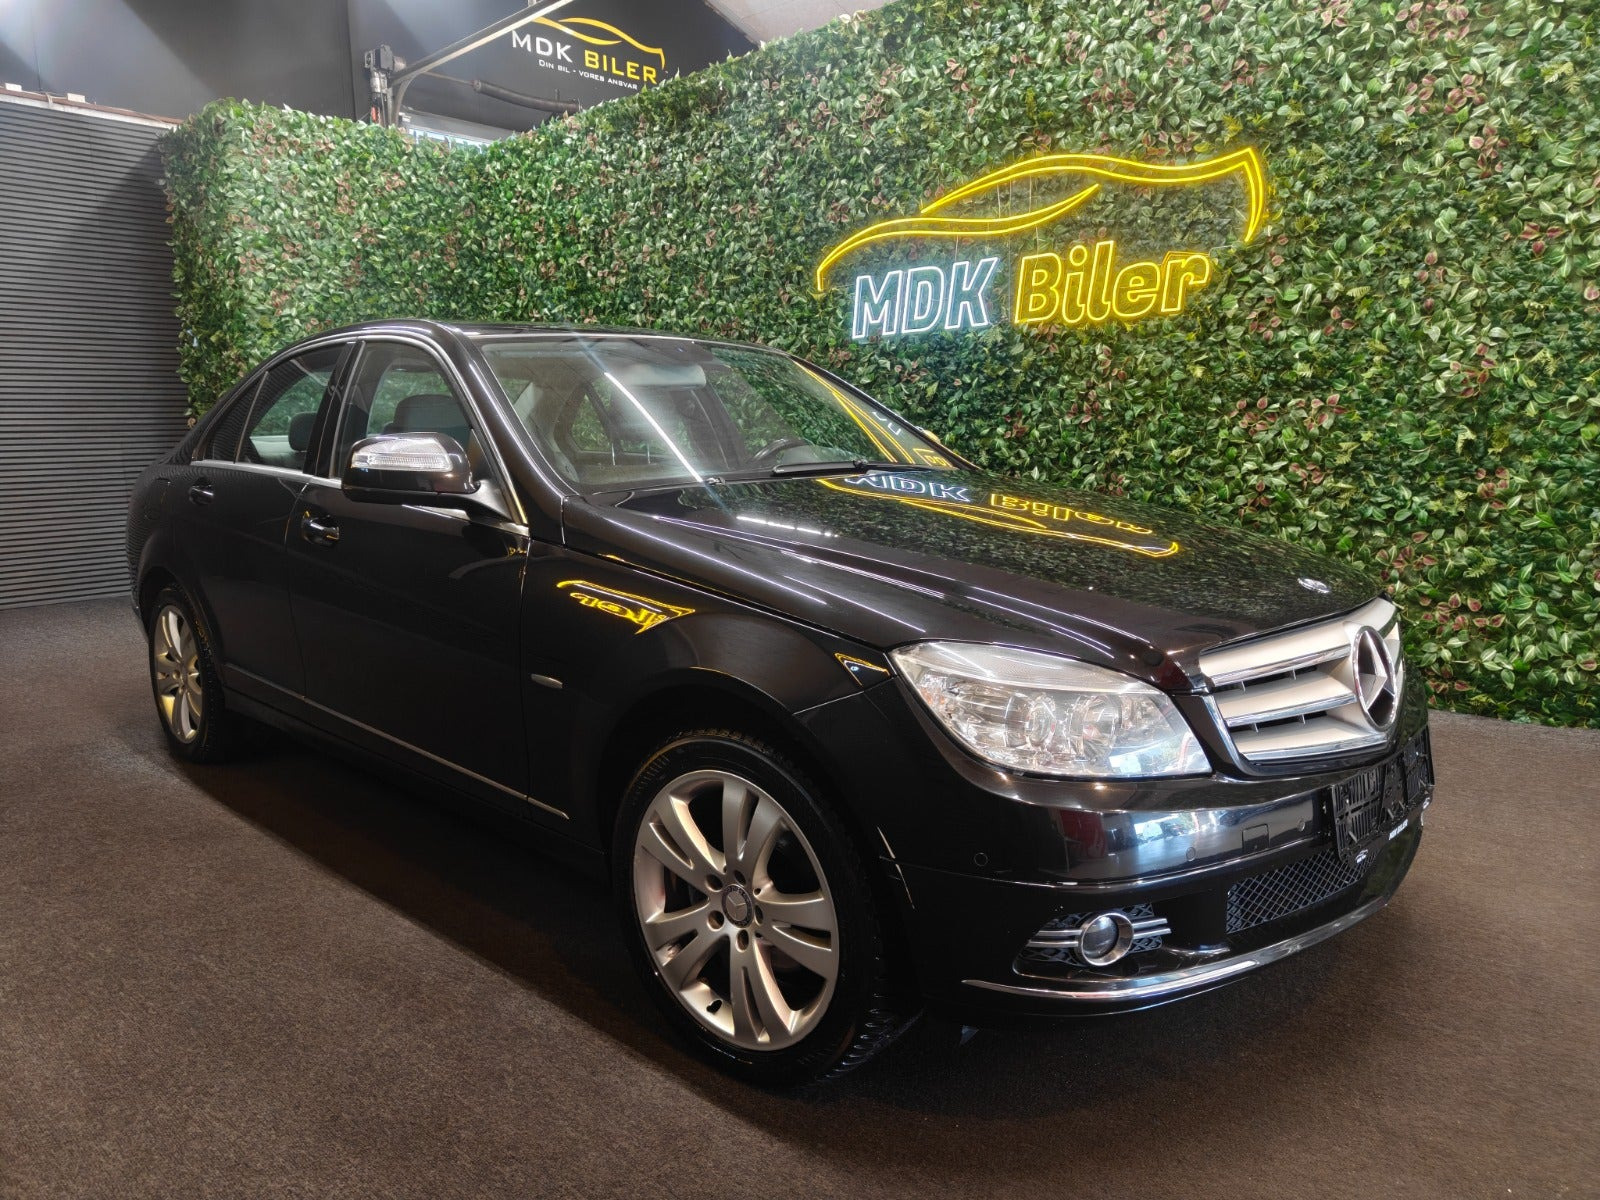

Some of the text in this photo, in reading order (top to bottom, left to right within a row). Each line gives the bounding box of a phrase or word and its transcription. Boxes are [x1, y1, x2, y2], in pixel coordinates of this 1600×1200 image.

[511, 29, 657, 85] MDK BILER
[557, 65, 571, 73] BIL
[578, 70, 605, 82] VORES
[607, 78, 638, 90] ANSVAR
[852, 240, 1211, 339] MDK Biler
